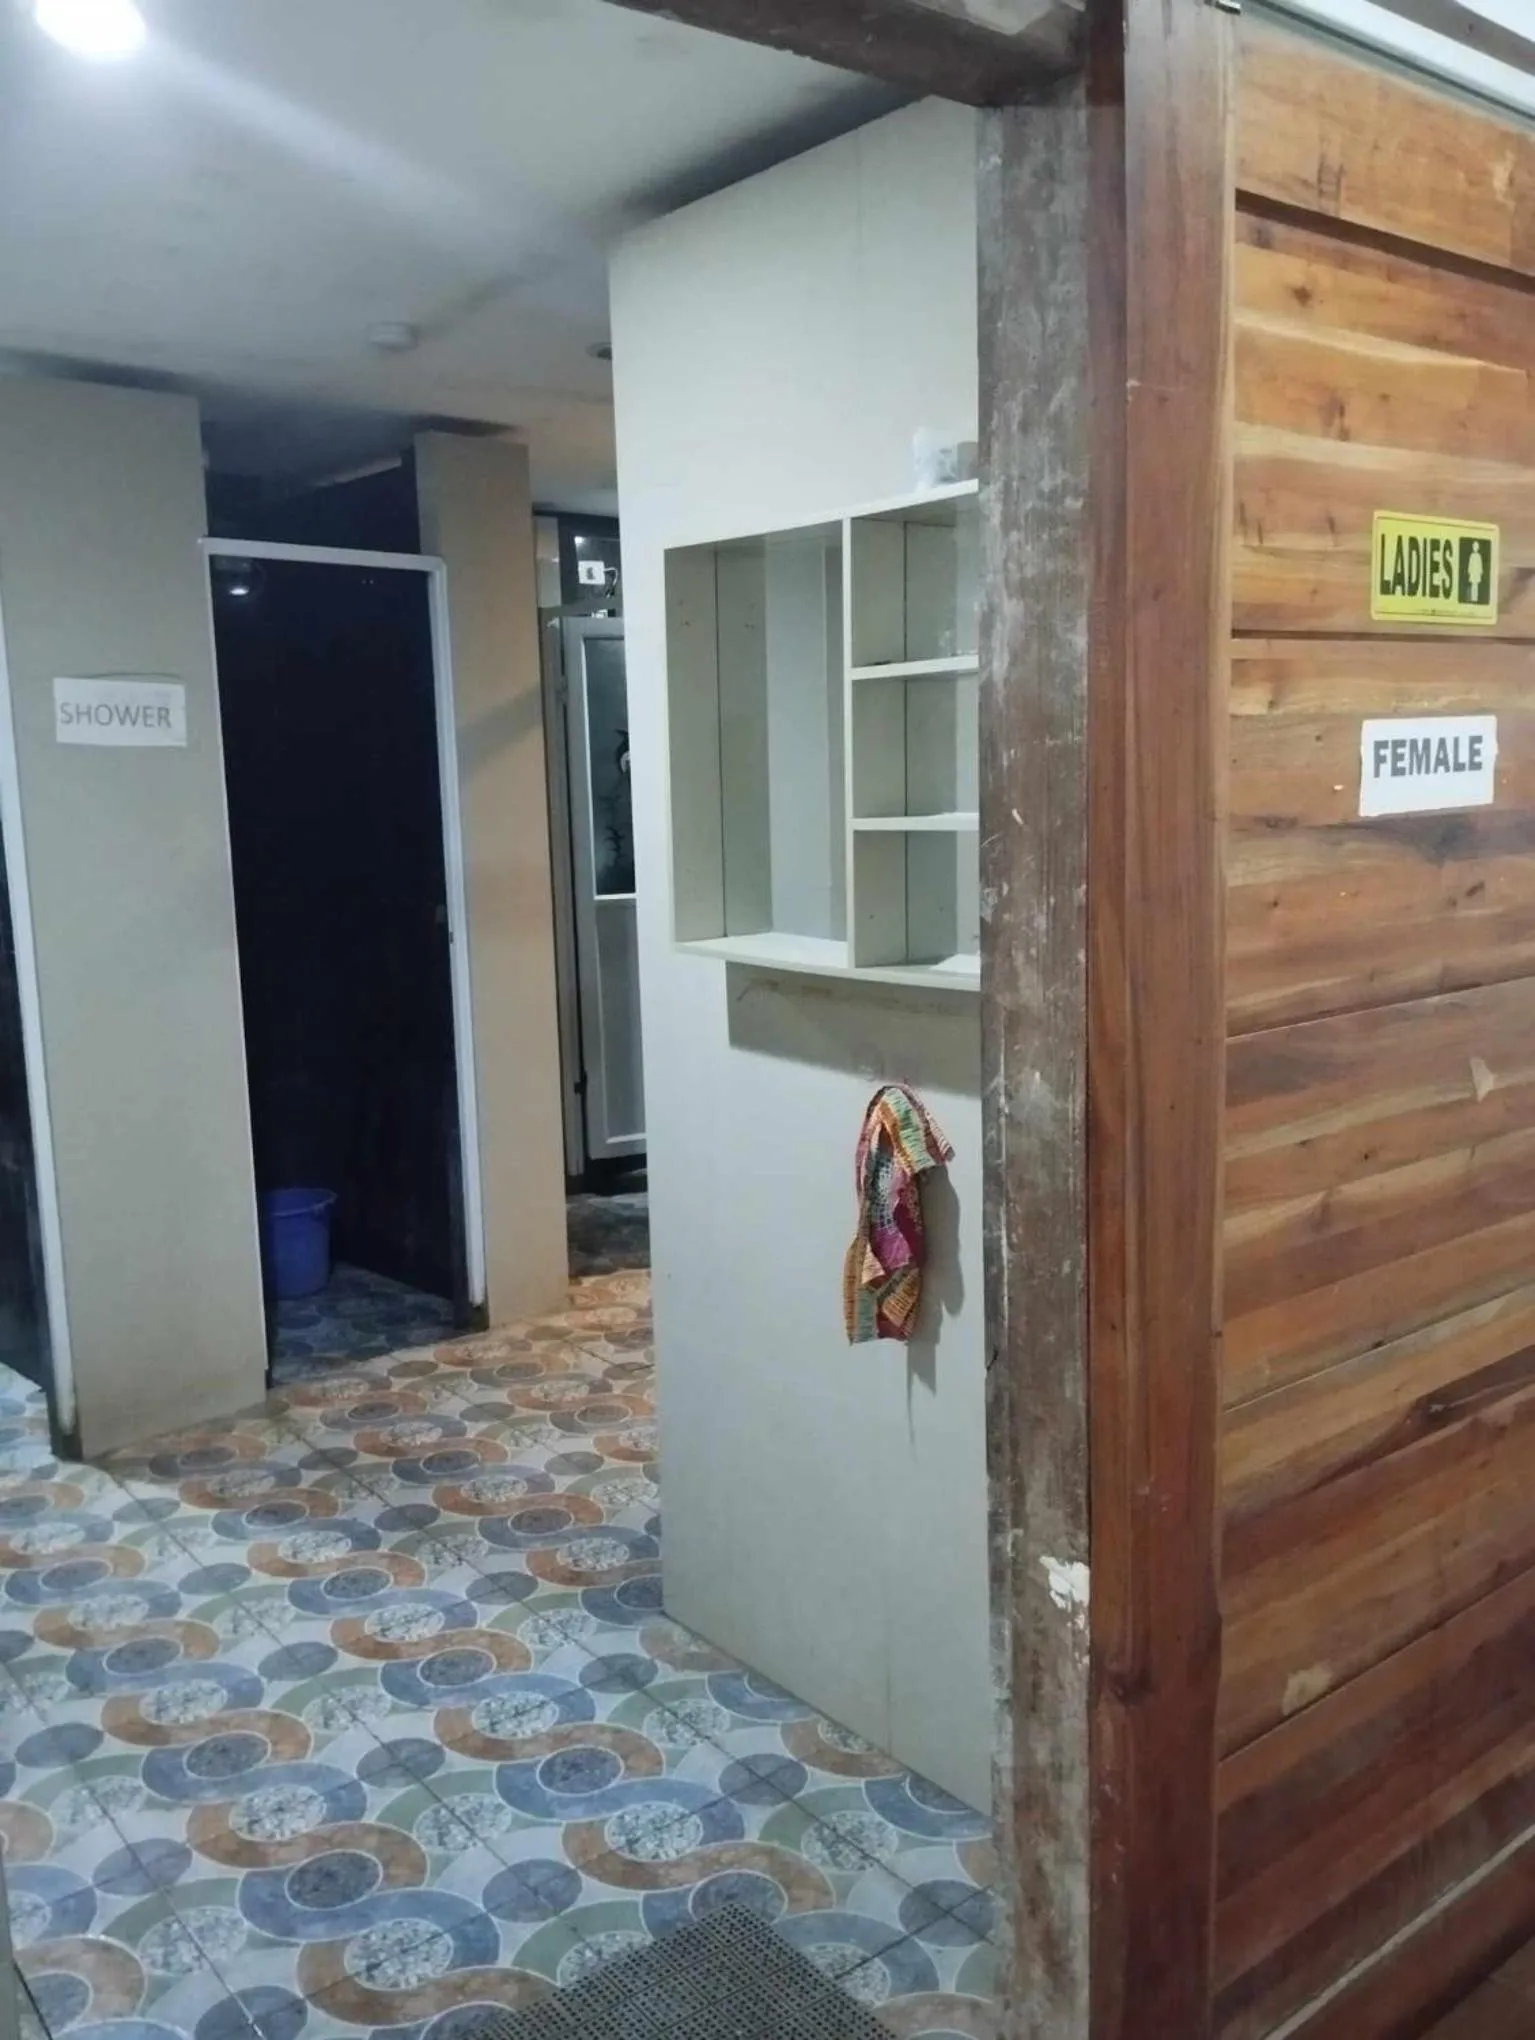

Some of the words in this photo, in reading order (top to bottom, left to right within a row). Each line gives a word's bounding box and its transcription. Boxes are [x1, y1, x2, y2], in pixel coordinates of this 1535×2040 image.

[1379, 533, 1453, 599] LADIES
[60, 702, 172, 728] SHOWER
[1373, 735, 1483, 778] FEMALE
